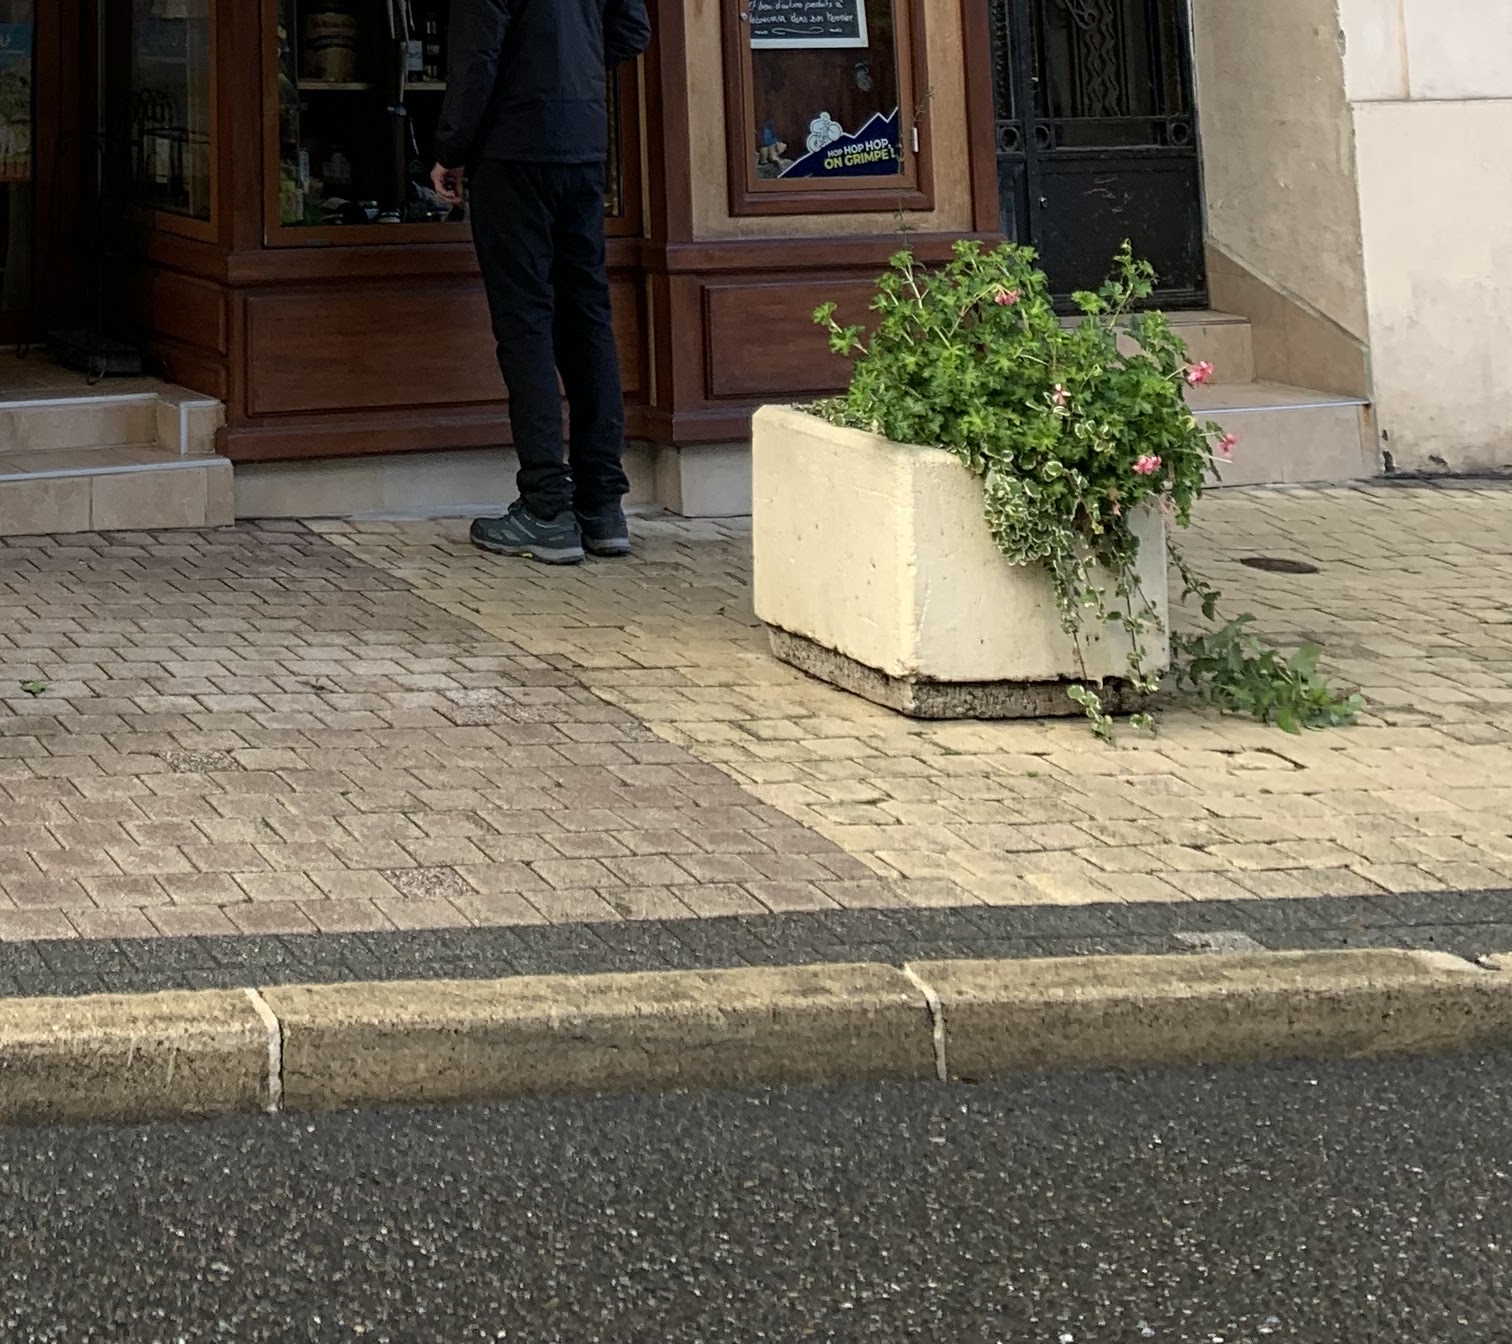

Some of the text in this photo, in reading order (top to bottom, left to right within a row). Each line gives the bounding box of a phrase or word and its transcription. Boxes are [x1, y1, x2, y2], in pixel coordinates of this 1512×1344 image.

[828, 148, 843, 158] HOP
[843, 143, 864, 155] HOP
[824, 157, 843, 170] ON
